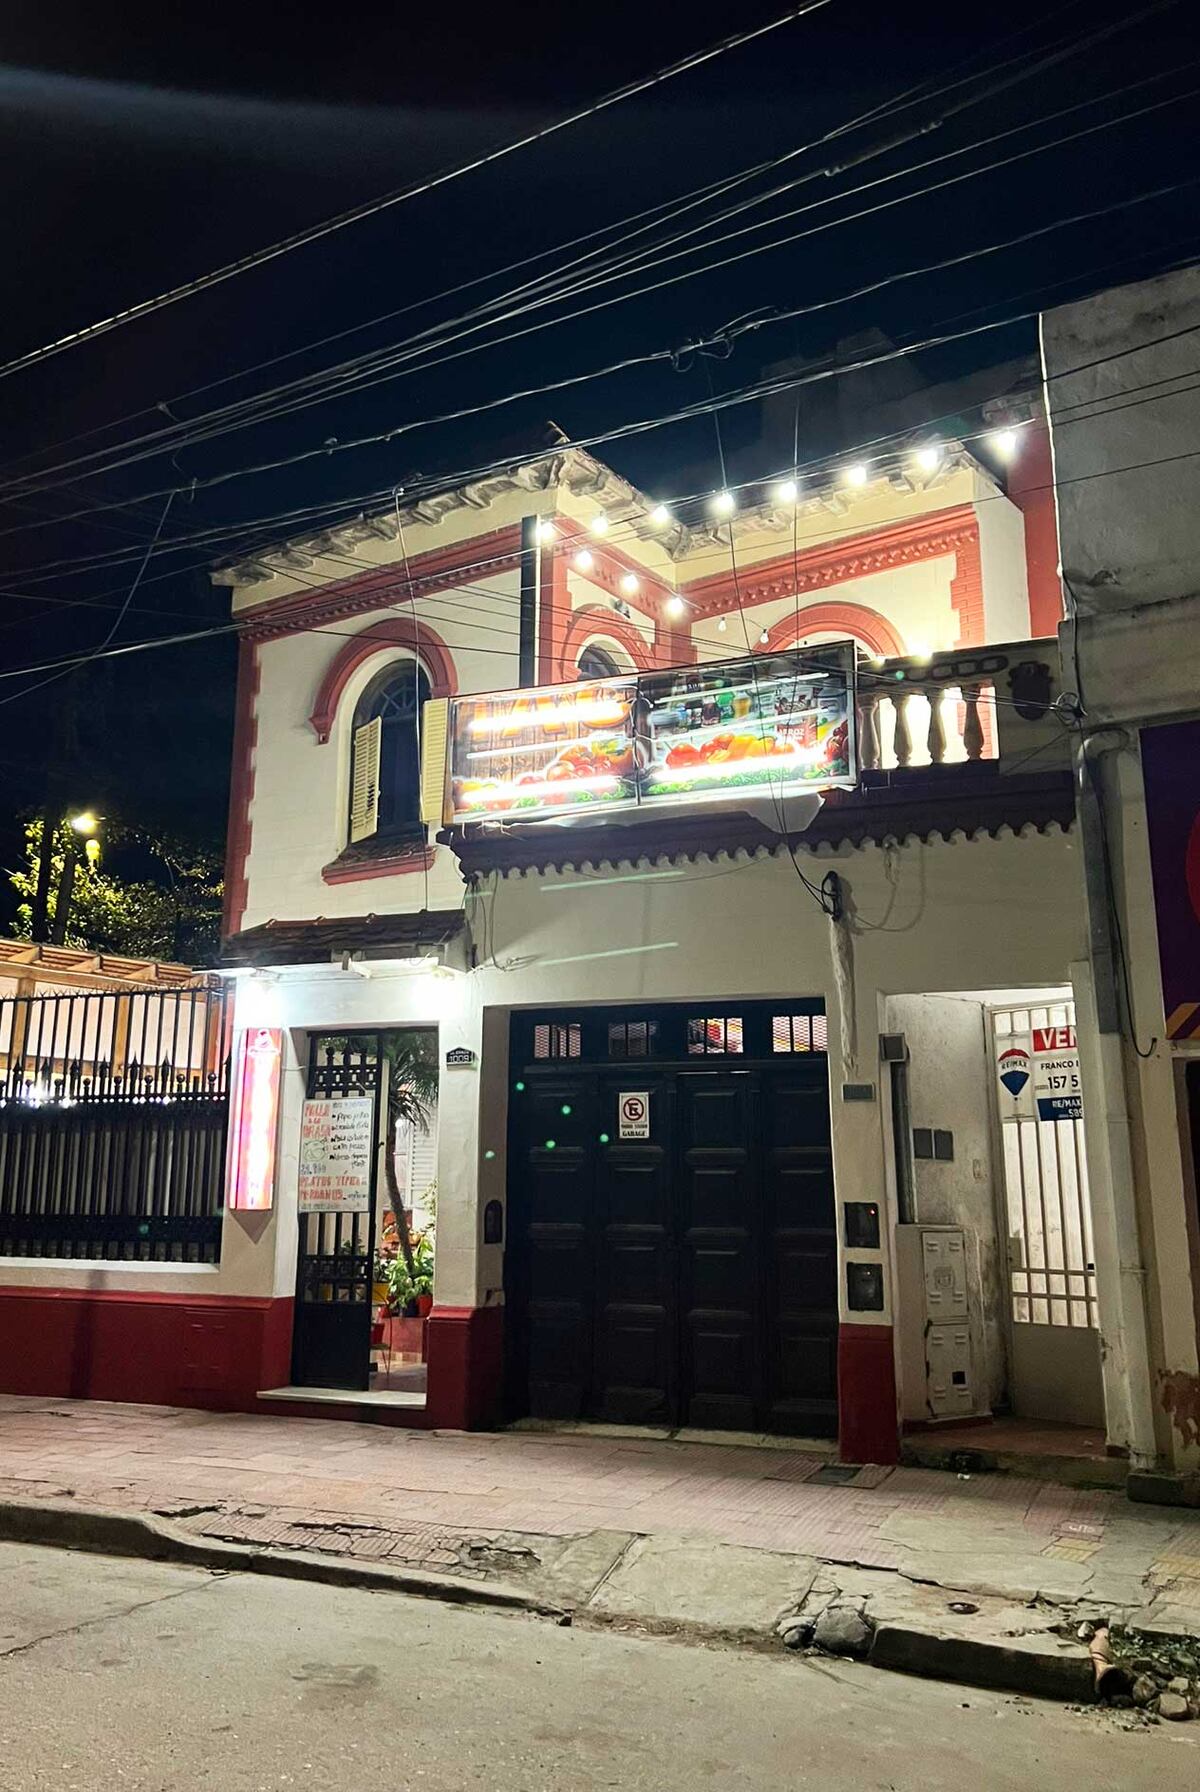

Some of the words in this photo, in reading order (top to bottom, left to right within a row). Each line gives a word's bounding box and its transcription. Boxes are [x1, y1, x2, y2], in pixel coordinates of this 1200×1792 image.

[1001, 1060, 1028, 1070] RE/MAX
[1040, 1060, 1074, 1070] FRANCO
[1047, 1075, 1067, 1090] 157
